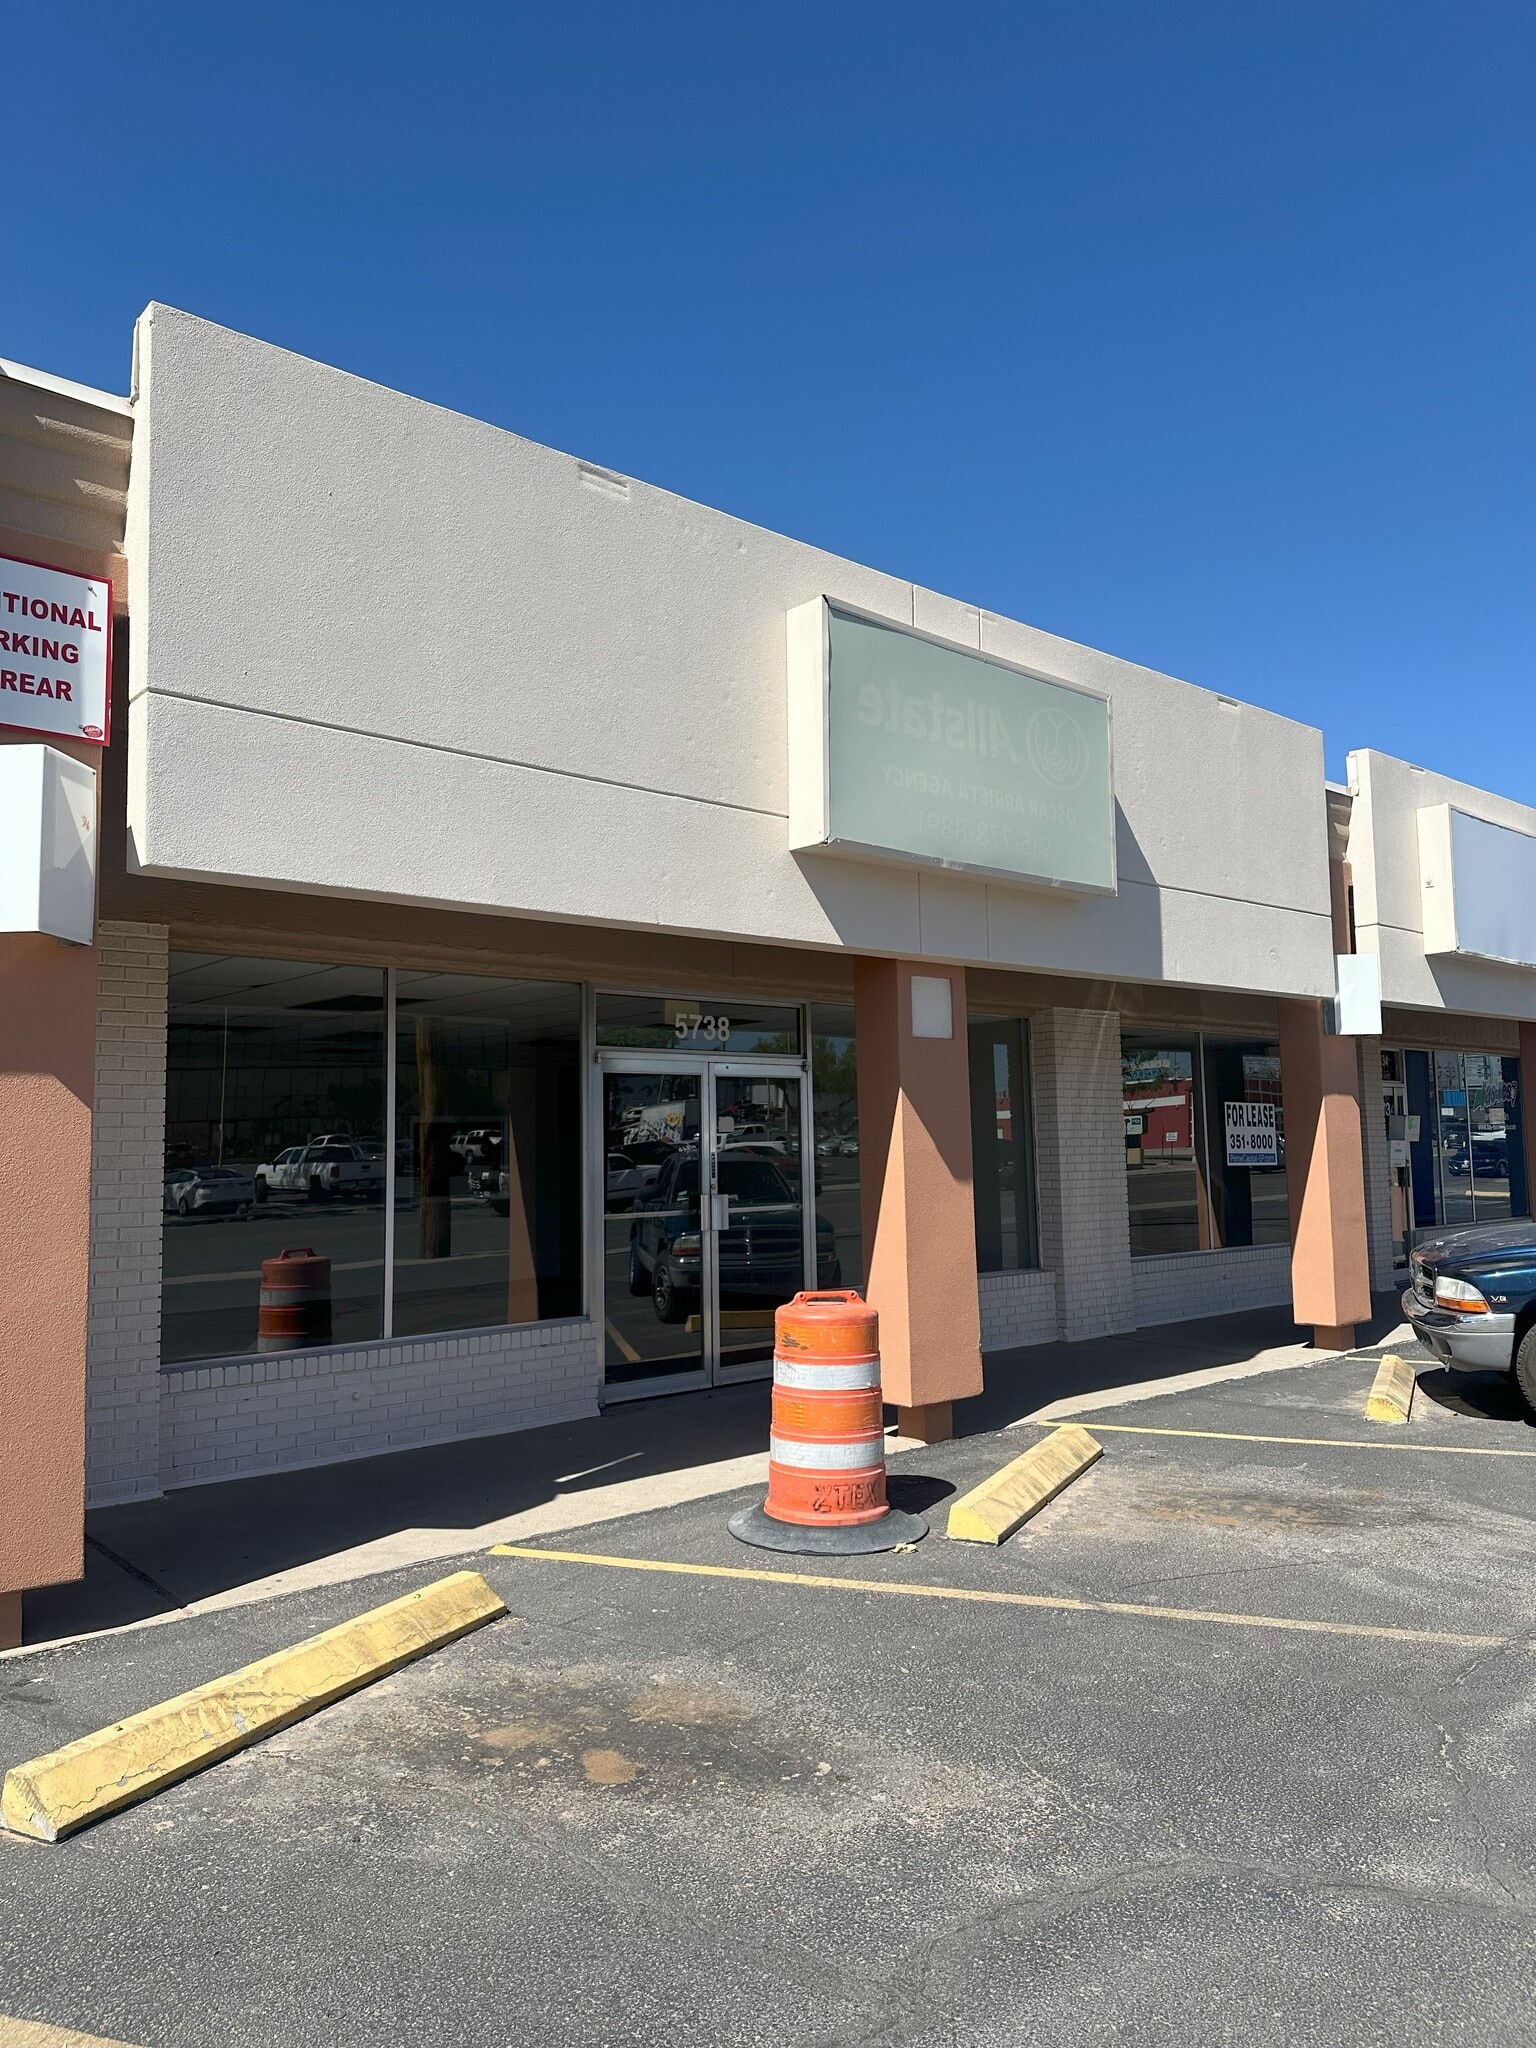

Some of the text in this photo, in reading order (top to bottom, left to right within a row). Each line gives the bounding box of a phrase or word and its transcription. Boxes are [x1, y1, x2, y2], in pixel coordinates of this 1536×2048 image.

[0, 591, 101, 632] TIONAL
[1, 669, 72, 701] REAR
[675, 1013, 730, 1042] 5738
[1226, 1104, 1274, 1128] FOR LEASE
[1230, 1133, 1273, 1149] 351-8000
